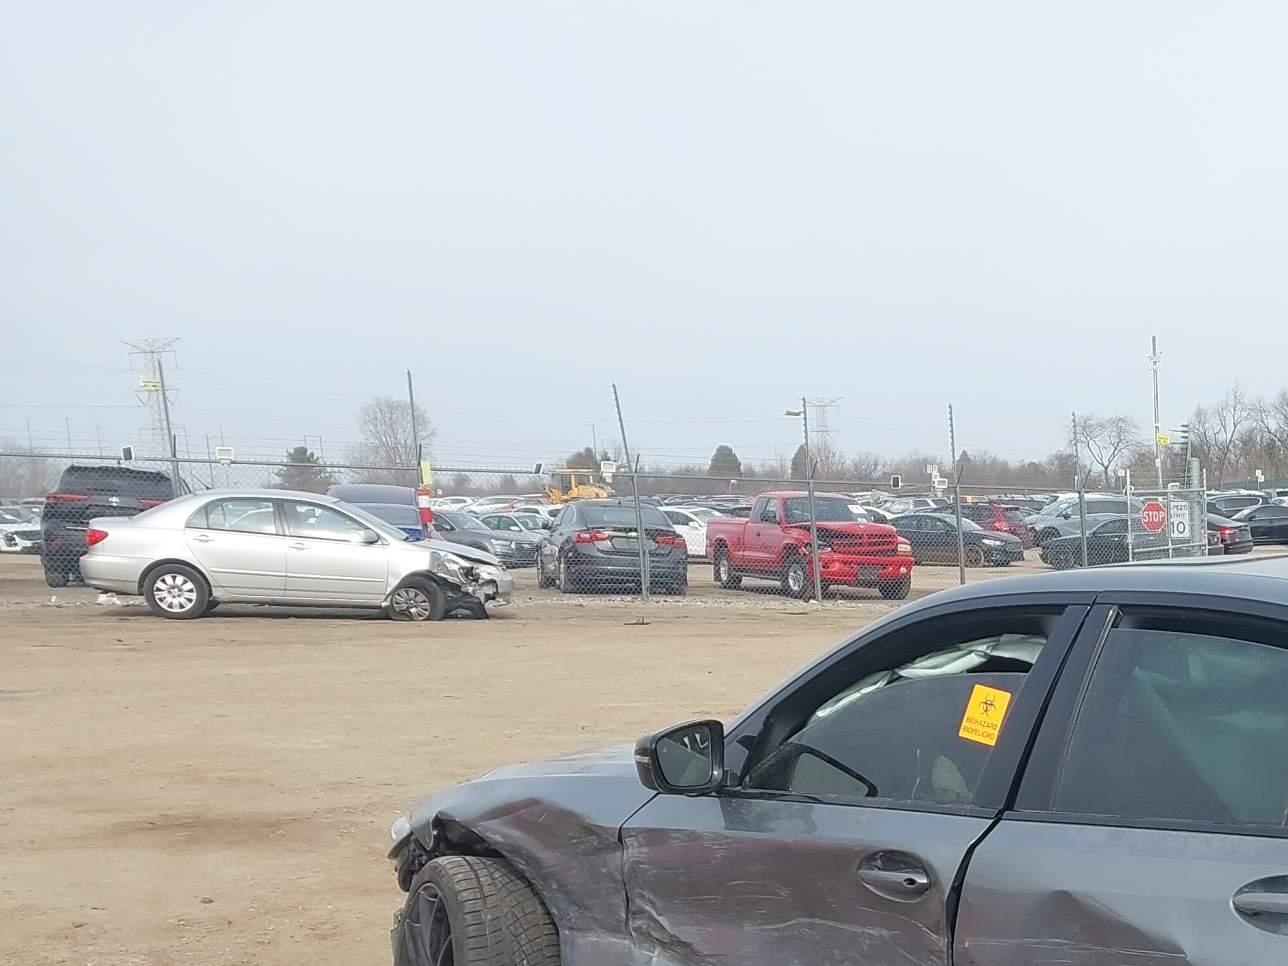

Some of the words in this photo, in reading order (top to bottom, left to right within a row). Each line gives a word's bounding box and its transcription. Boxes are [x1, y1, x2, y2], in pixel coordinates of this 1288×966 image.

[1143, 511, 1165, 522] STOP
[1171, 521, 1186, 535] 10
[965, 716, 998, 731] BIOHAZARD
[962, 725, 996, 741] BIOPELIGRO
